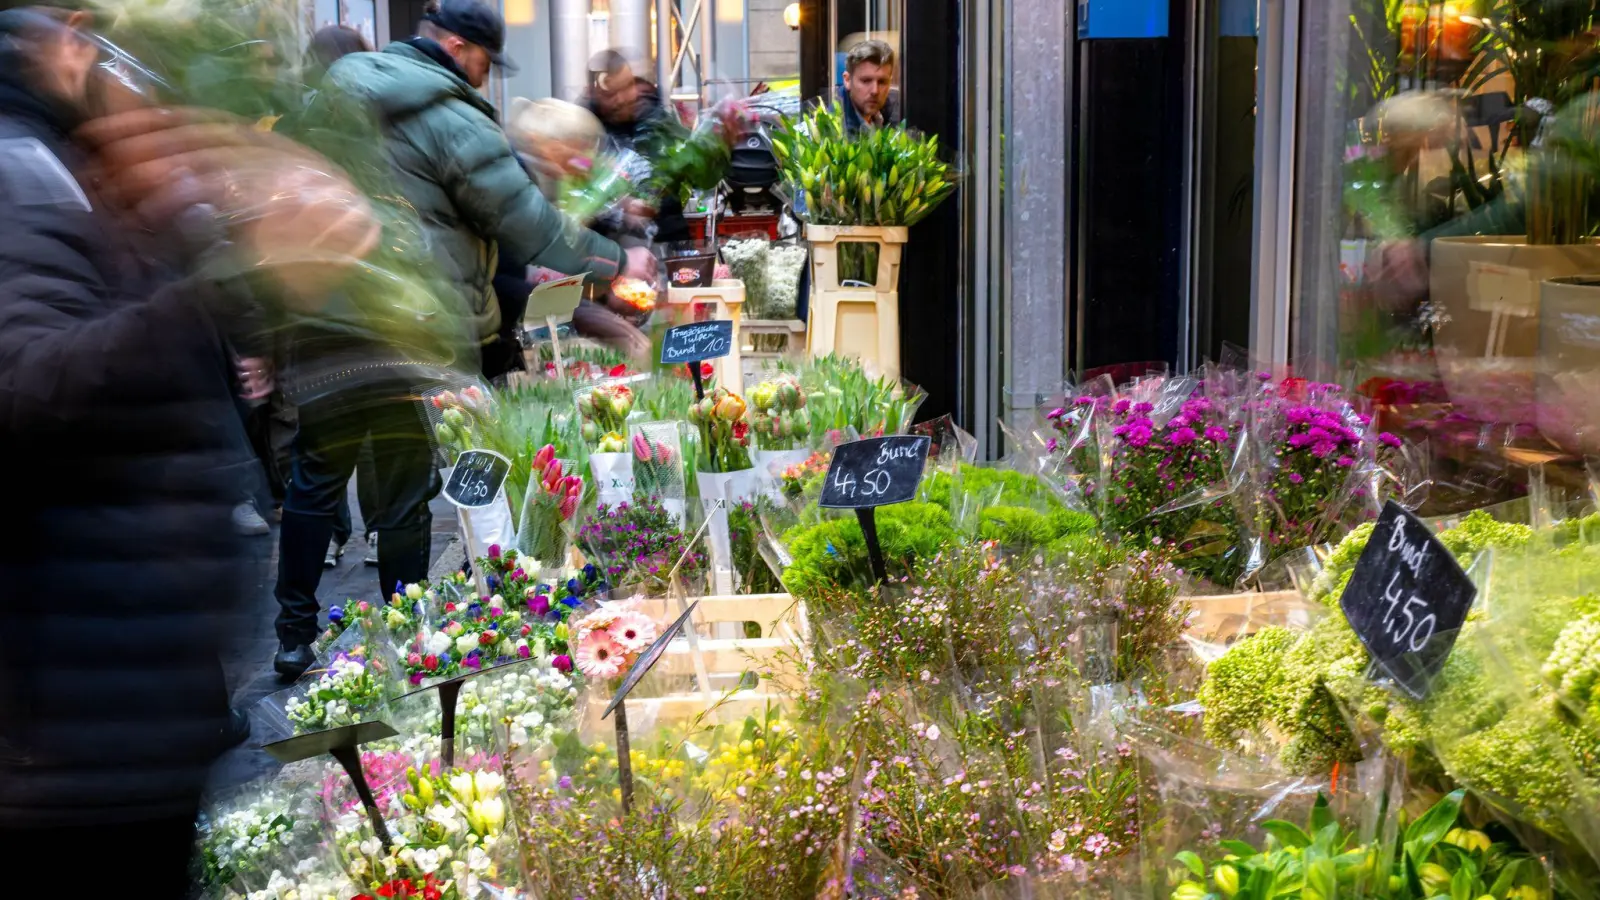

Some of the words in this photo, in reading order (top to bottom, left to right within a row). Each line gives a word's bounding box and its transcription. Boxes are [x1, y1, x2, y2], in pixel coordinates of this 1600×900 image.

[667, 344, 696, 358] Bund
[877, 439, 922, 465] Bund
[834, 466, 891, 498] 4,50
[1388, 515, 1429, 578] Bund
[1382, 572, 1436, 652] 4,50
